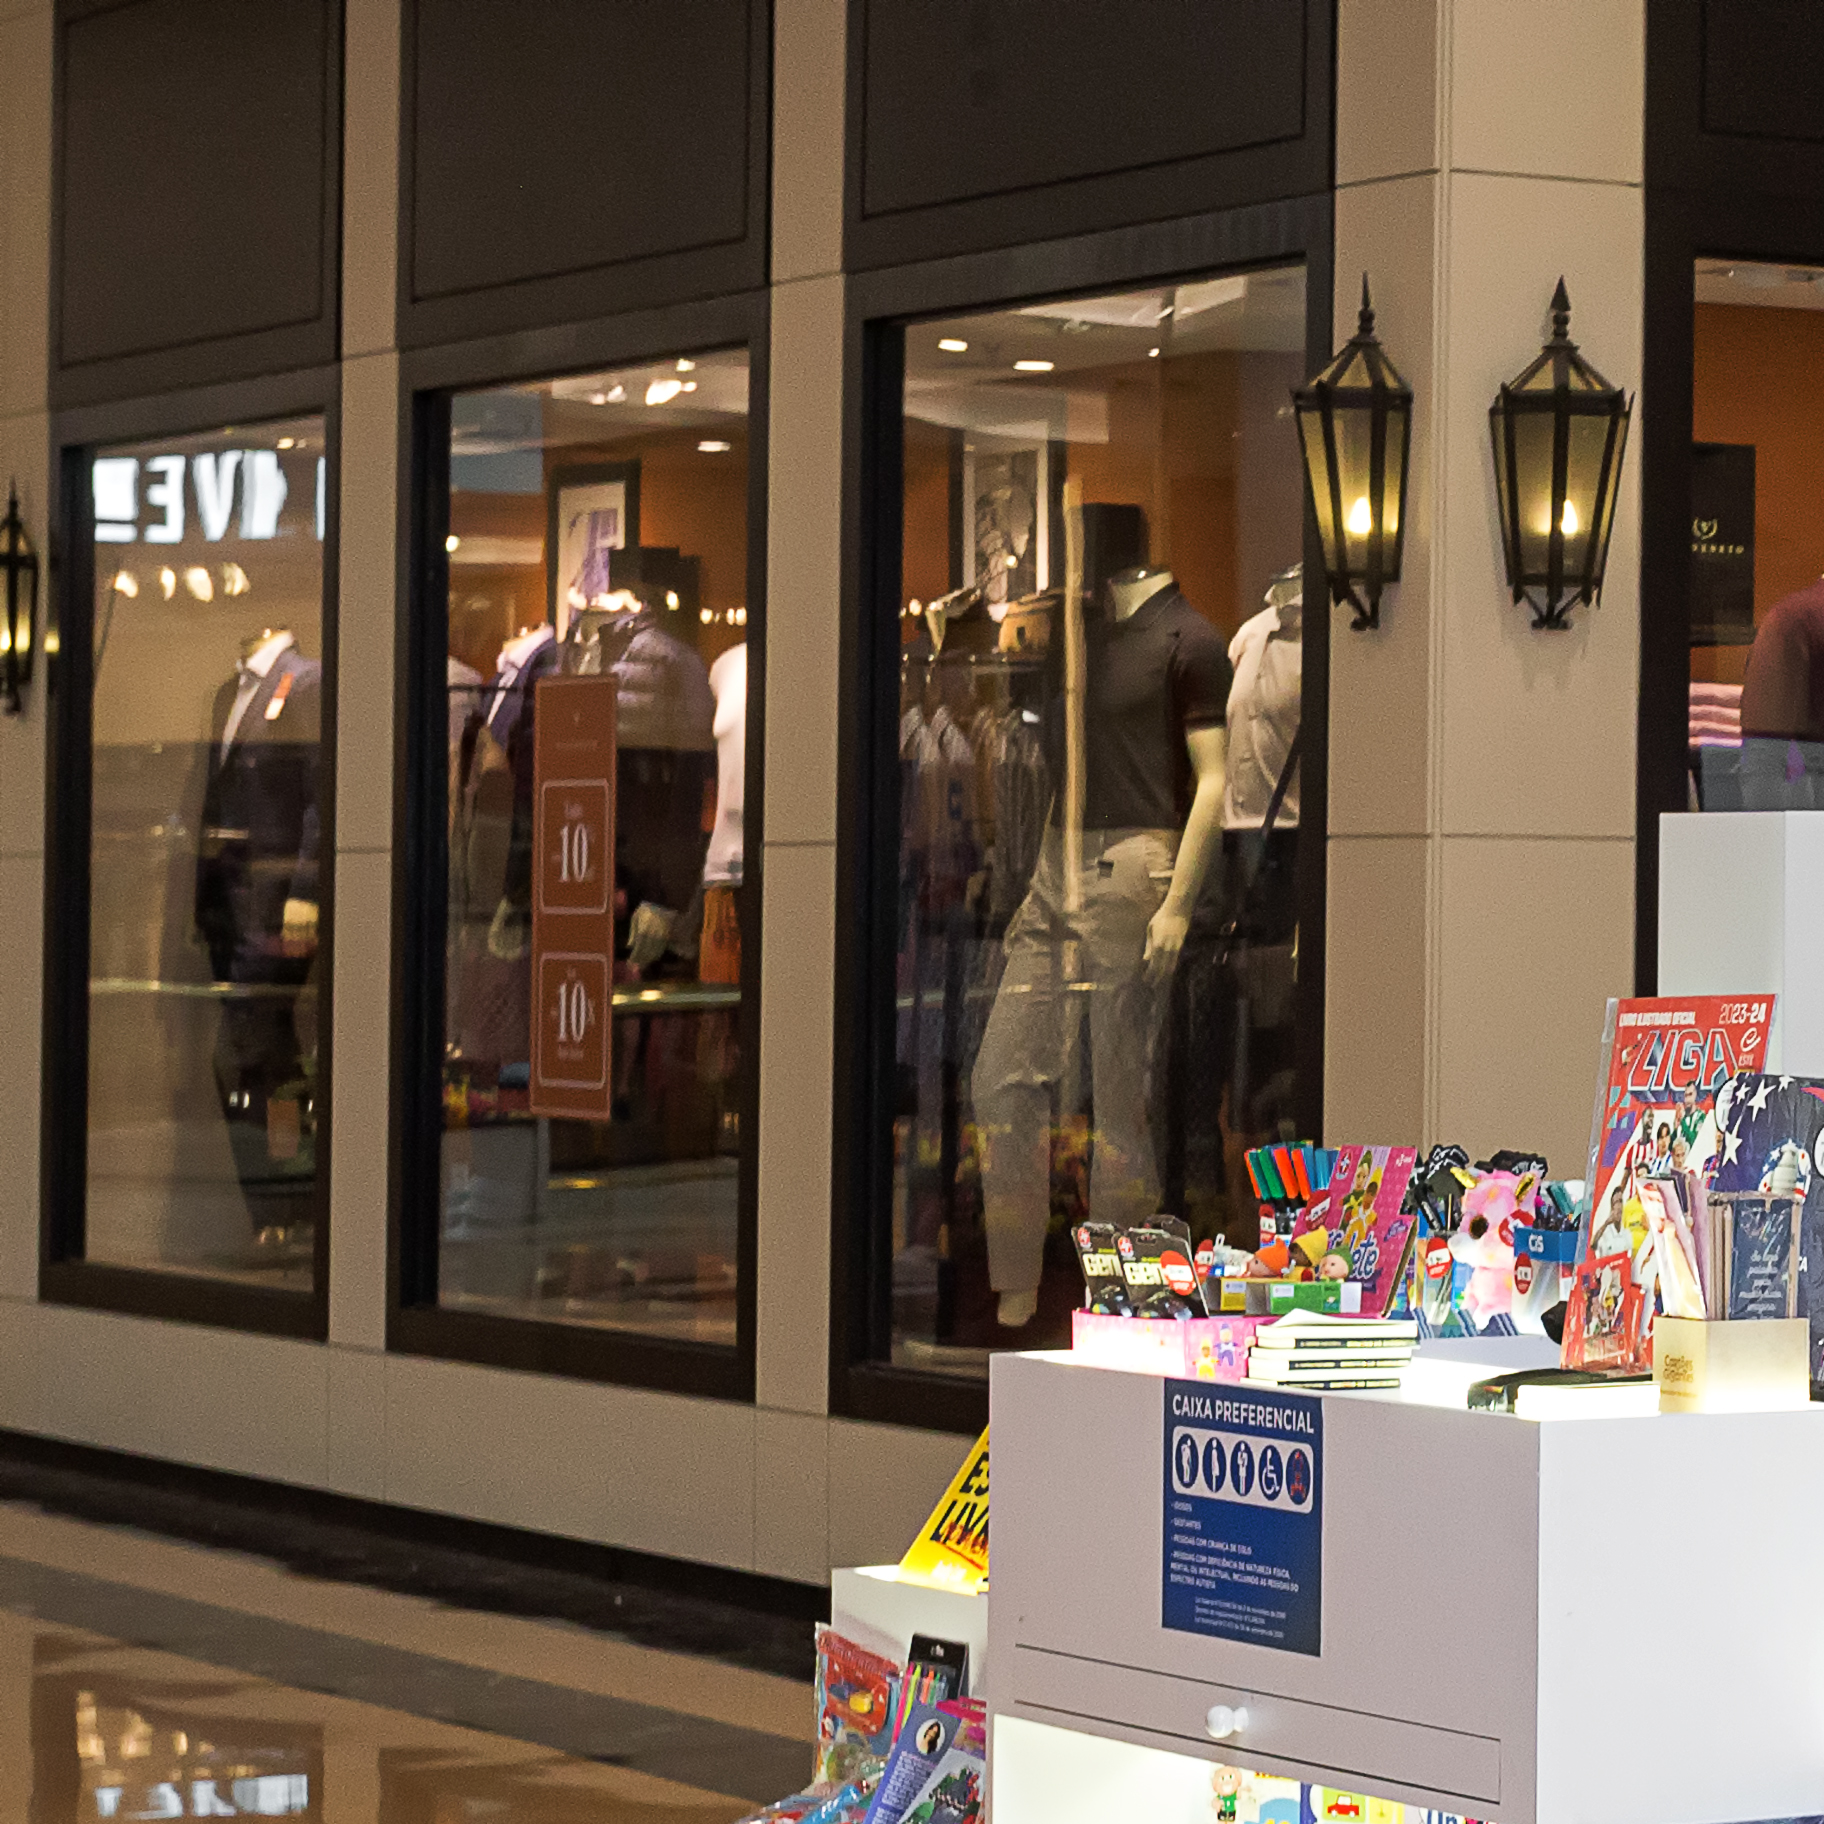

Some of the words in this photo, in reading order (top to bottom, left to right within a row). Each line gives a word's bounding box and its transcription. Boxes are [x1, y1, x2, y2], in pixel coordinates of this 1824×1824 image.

[1718, 1002, 1767, 1026] 2023-24
[1627, 1028, 1740, 1098] LIGA
[1172, 1394, 1213, 1420] CAIXA
[1215, 1400, 1315, 1434] PREFERENCIAL
